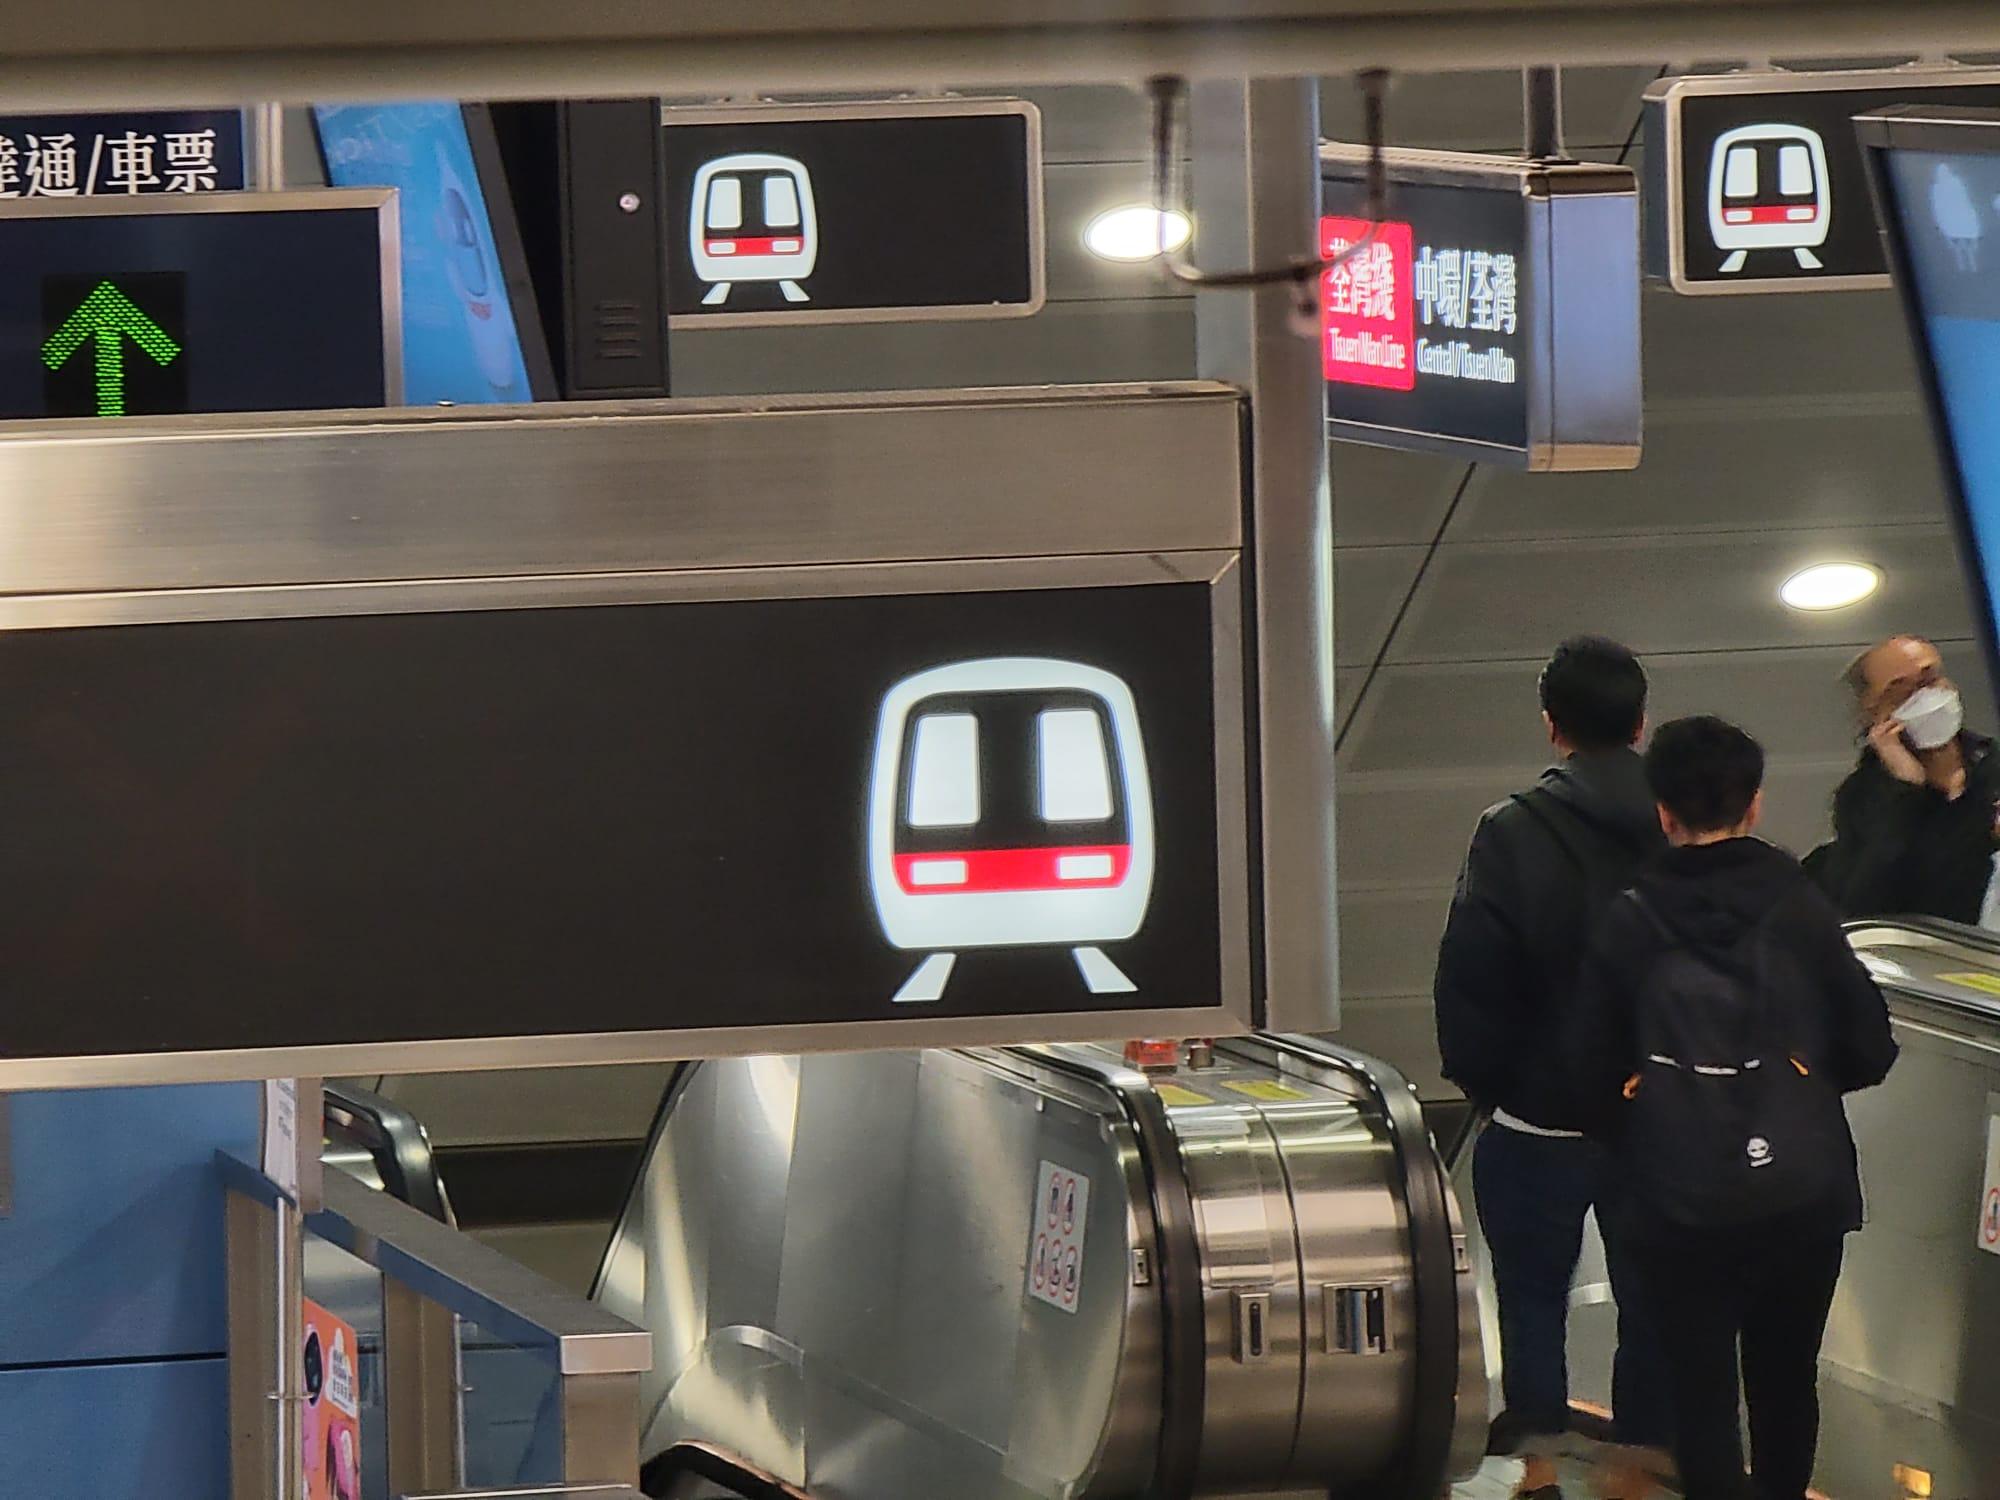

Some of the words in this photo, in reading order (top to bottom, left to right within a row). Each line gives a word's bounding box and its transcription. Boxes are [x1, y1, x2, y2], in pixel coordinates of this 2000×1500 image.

[1328, 239, 1395, 320] 荃灣線
[1415, 246, 1516, 334] 中環/荃灣
[1329, 327, 1359, 363] Tsuen
[1358, 331, 1382, 366] Wan
[1381, 334, 1405, 369] Line
[1488, 347, 1516, 383] Wan
